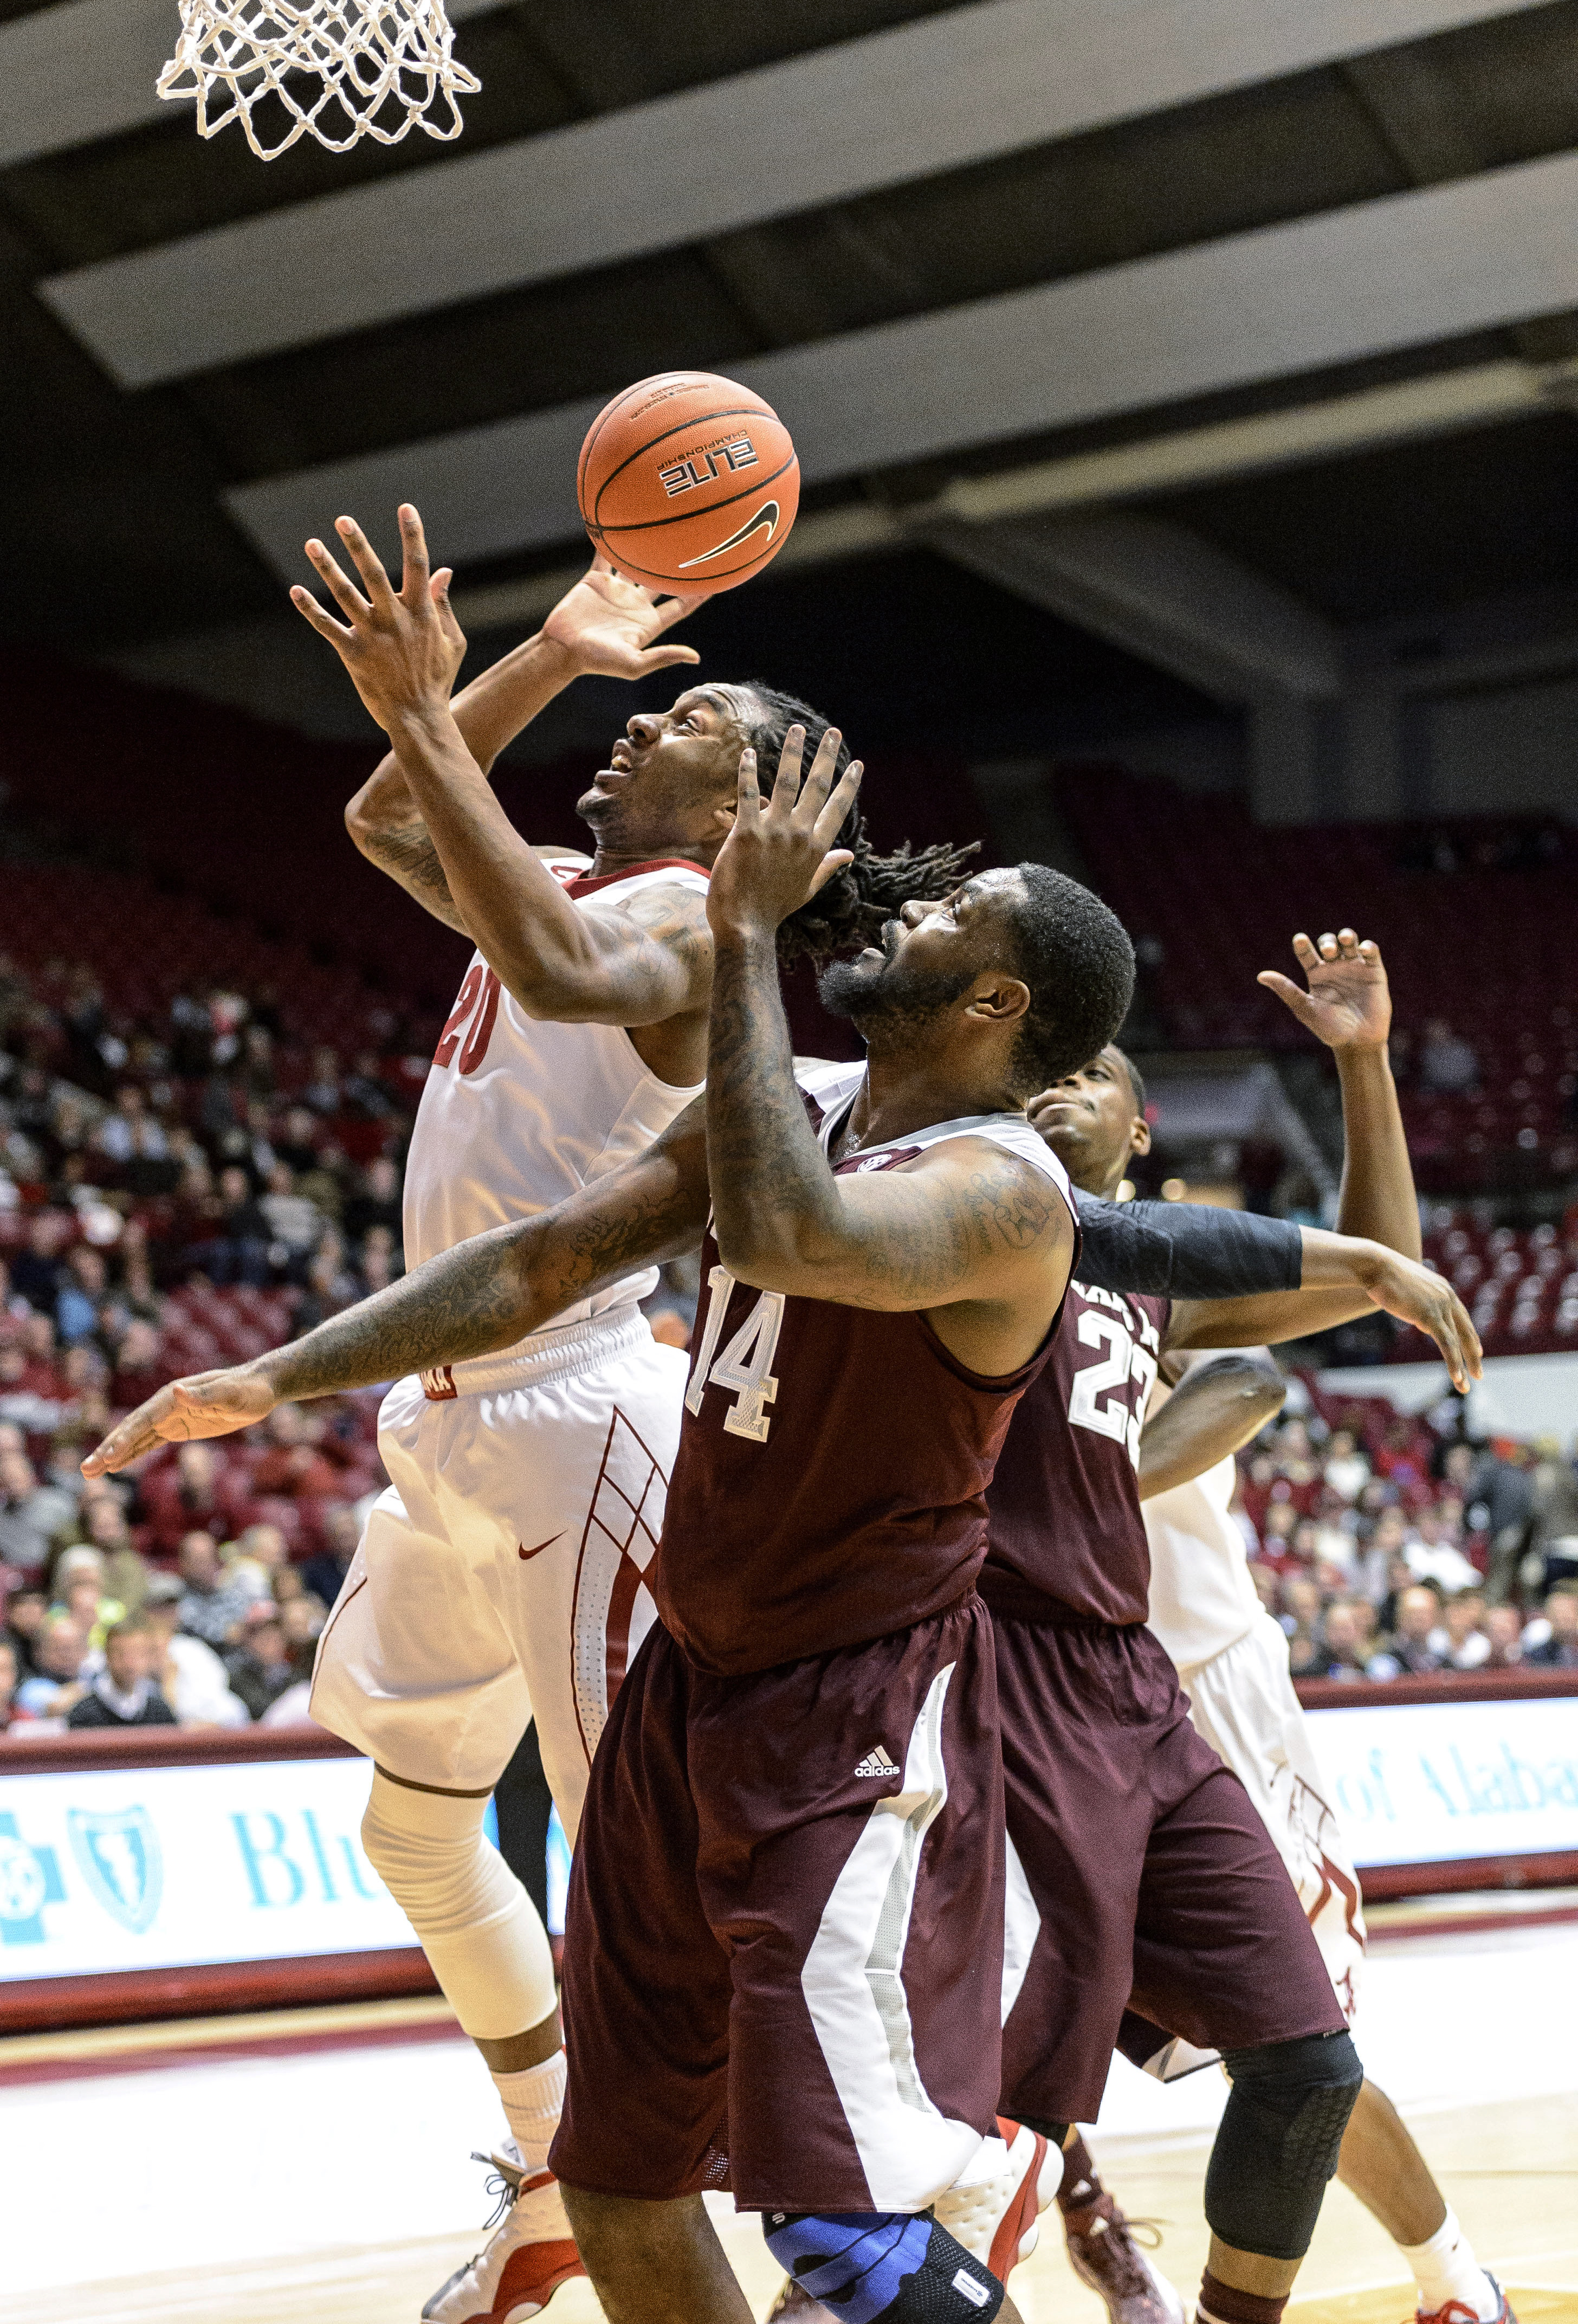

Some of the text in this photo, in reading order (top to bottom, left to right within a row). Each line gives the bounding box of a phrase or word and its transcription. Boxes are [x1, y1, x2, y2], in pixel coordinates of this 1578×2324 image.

[657, 430, 748, 470] CHAMPIONSHIP
[658, 437, 759, 498] ELITE
[431, 964, 501, 1075] 20
[684, 1264, 785, 1443] 14
[854, 1765, 900, 1777] adidas
[1335, 1746, 1396, 1823] of
